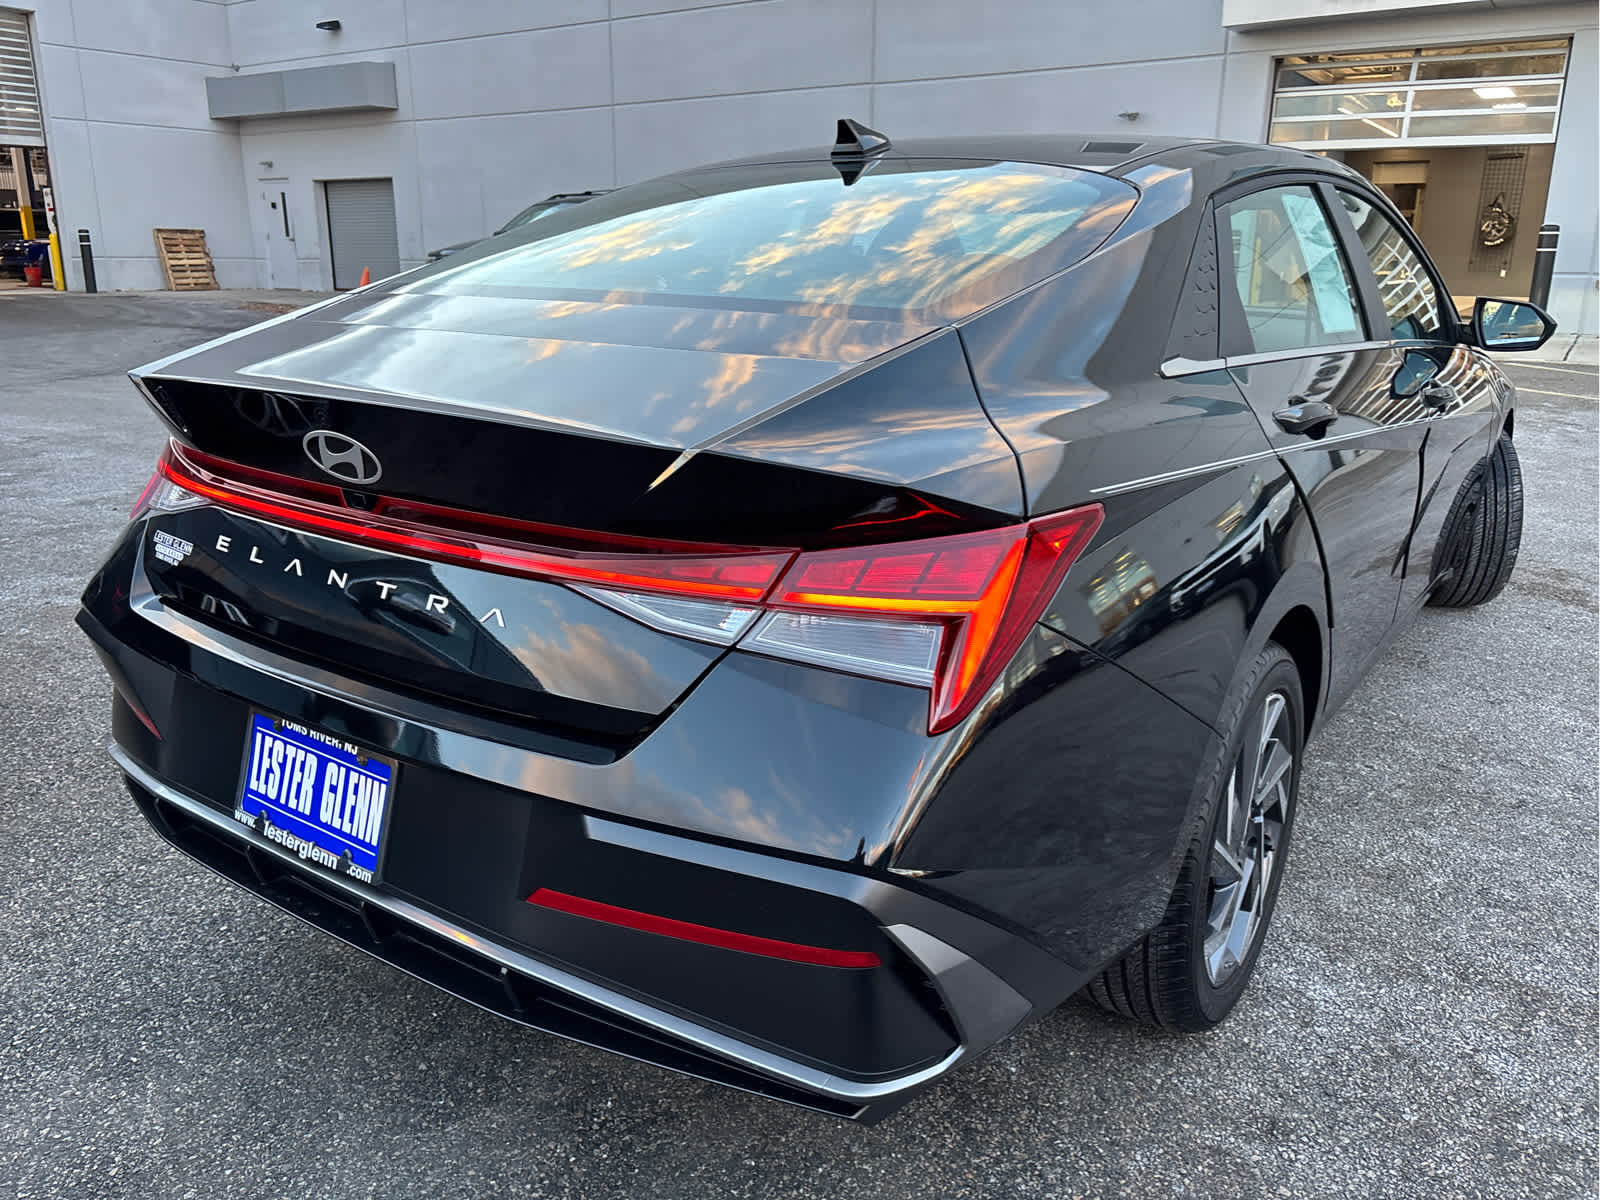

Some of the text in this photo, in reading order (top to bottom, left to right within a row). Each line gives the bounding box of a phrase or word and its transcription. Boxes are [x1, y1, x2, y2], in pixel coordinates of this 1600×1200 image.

[154, 531, 173, 546] LESTER
[173, 540, 193, 554] GLENN
[215, 534, 506, 628] ELANTRA
[249, 731, 387, 847] LESTER GLENN
[234, 809, 372, 884] www. lesterglenn .com
